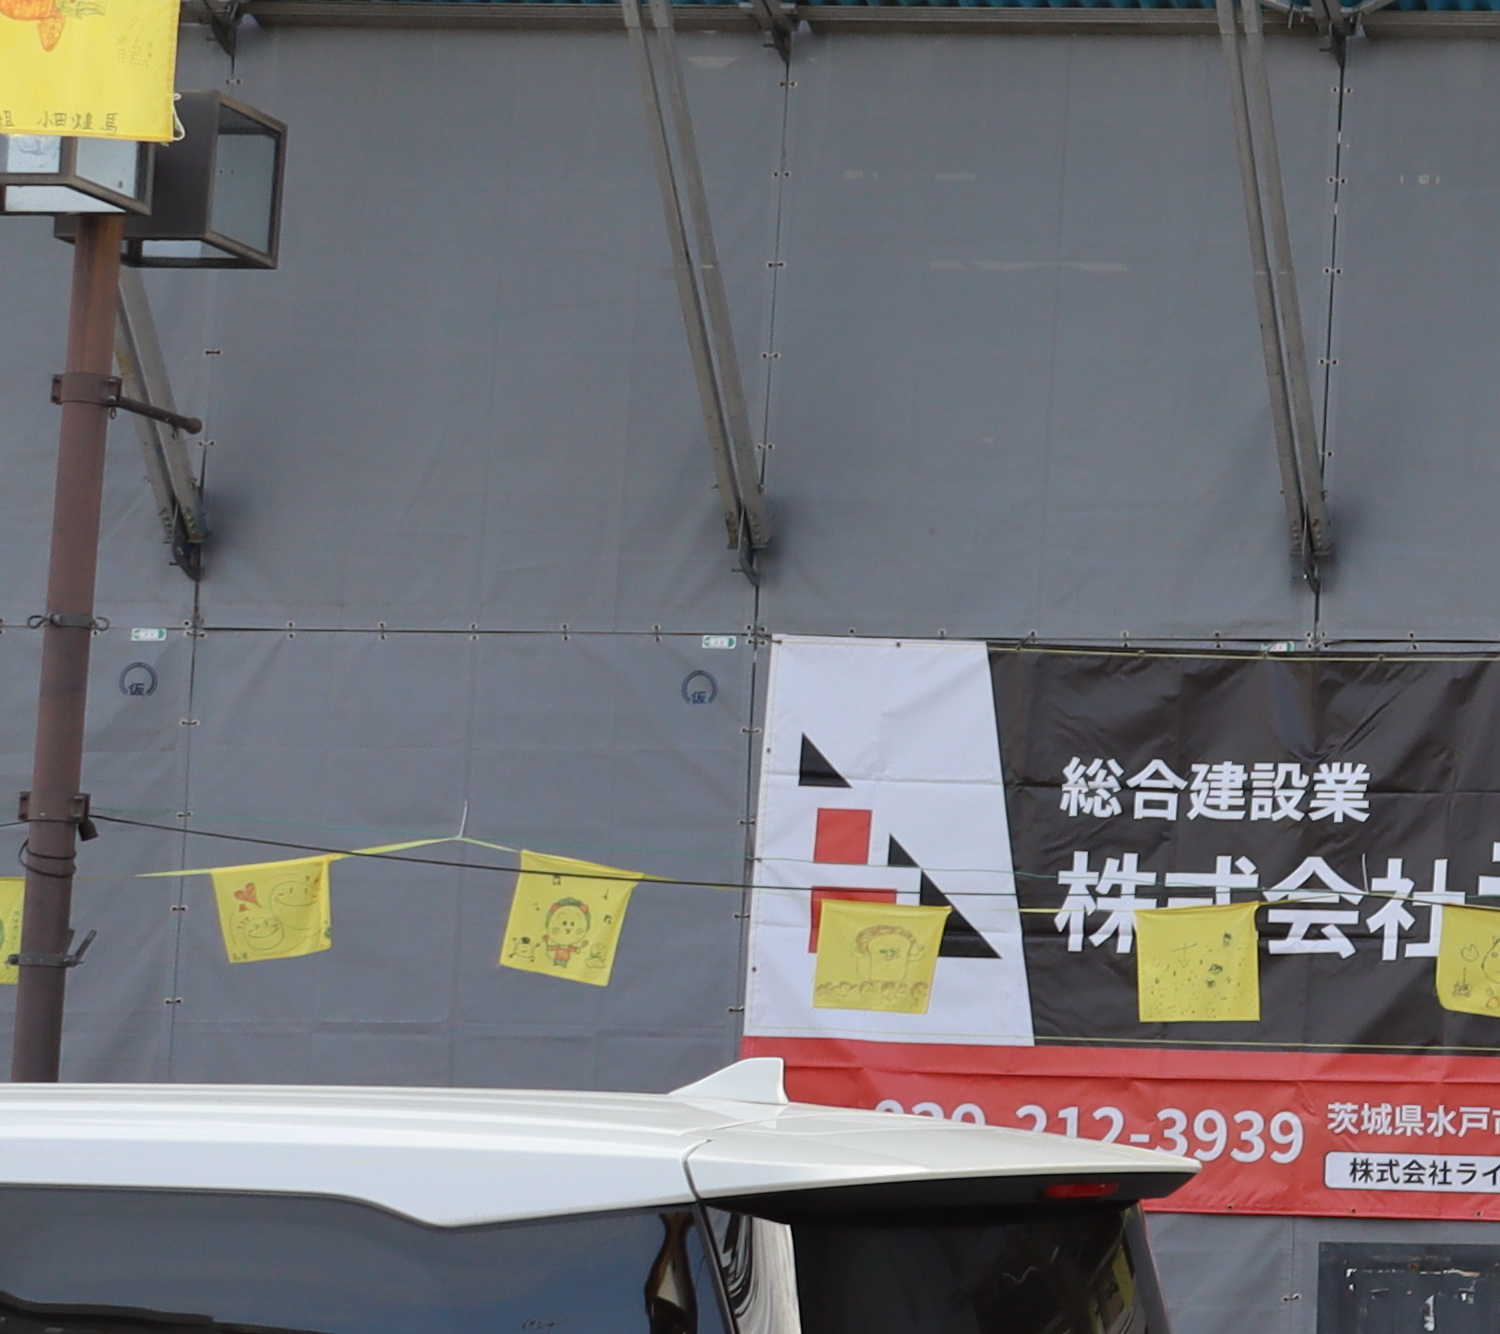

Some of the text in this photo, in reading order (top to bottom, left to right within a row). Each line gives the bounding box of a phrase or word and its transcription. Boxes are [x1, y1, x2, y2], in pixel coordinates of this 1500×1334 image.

[1059, 755, 1371, 823] 総合建設業
